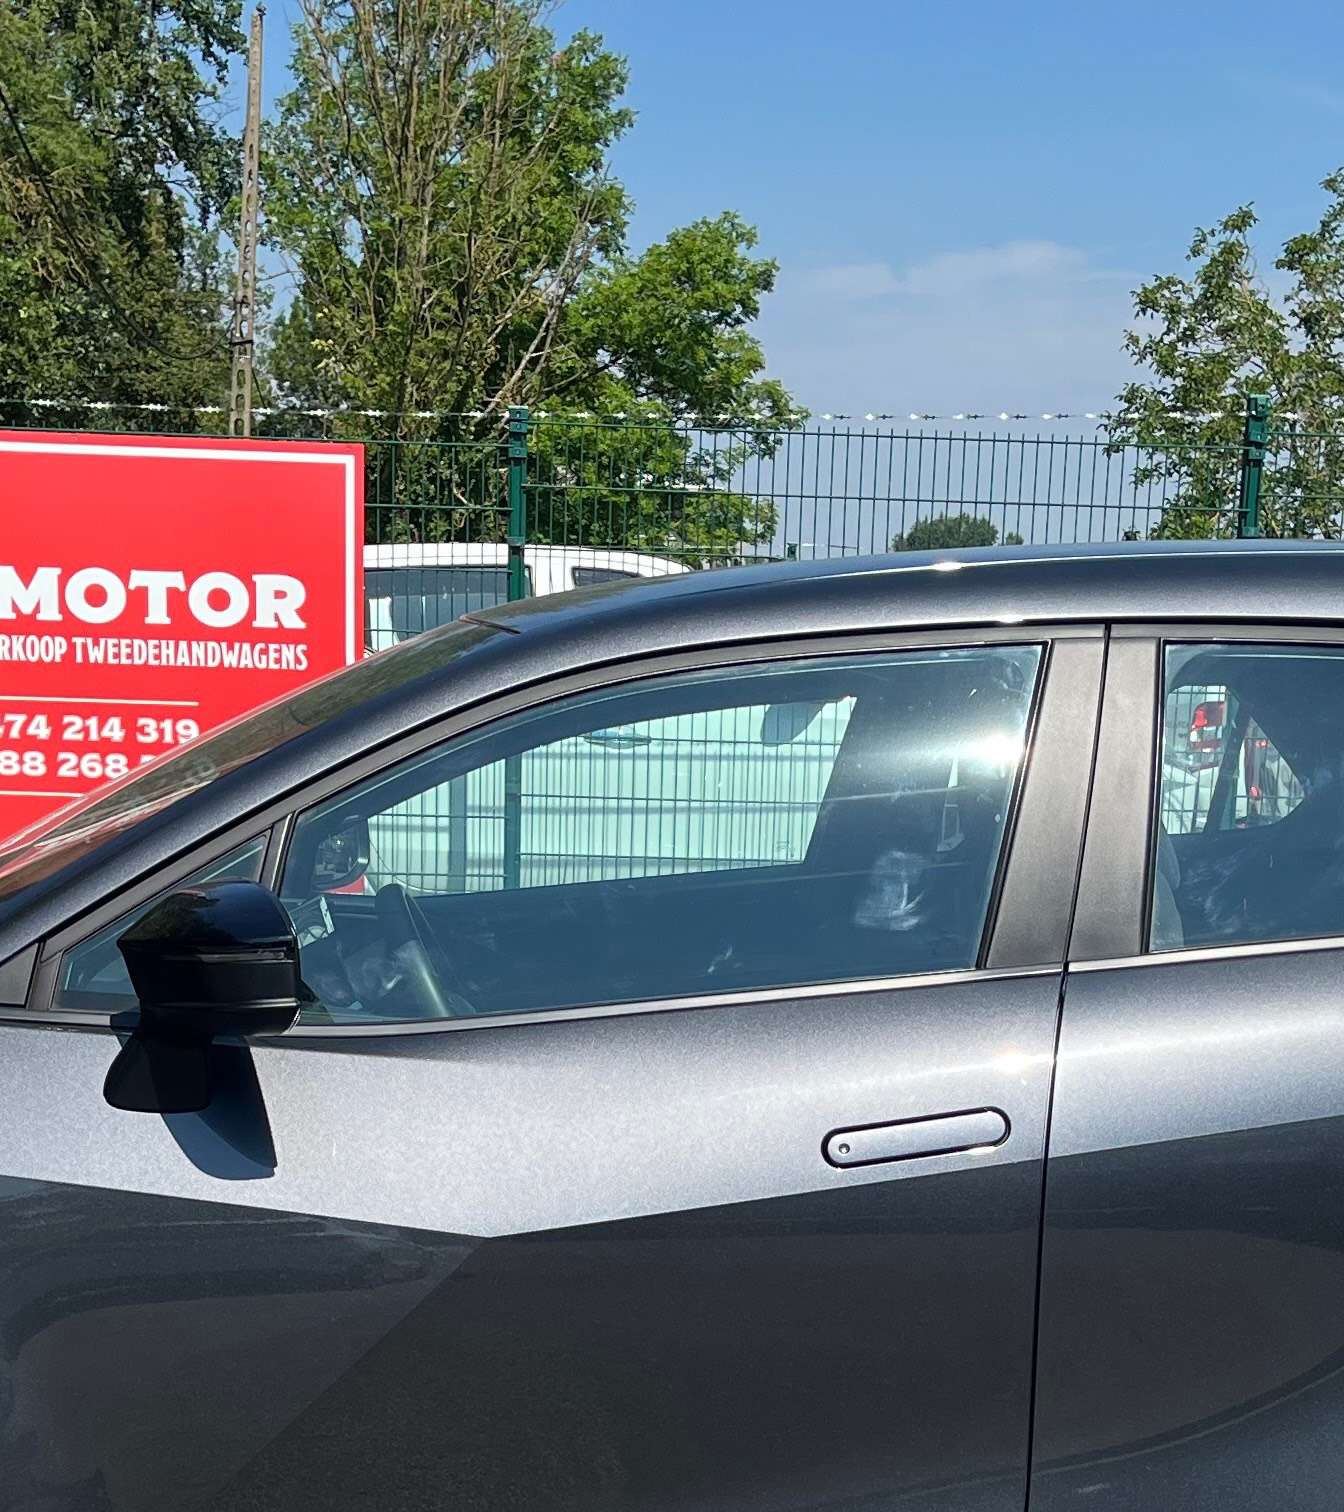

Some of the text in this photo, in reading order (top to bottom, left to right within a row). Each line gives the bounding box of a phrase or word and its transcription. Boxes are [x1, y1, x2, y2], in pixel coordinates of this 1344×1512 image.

[72, 637, 308, 671] TWEEDEHANDWAGENS
[62, 715, 125, 742] 214
[136, 717, 200, 744] 319
[57, 751, 128, 779] 268
